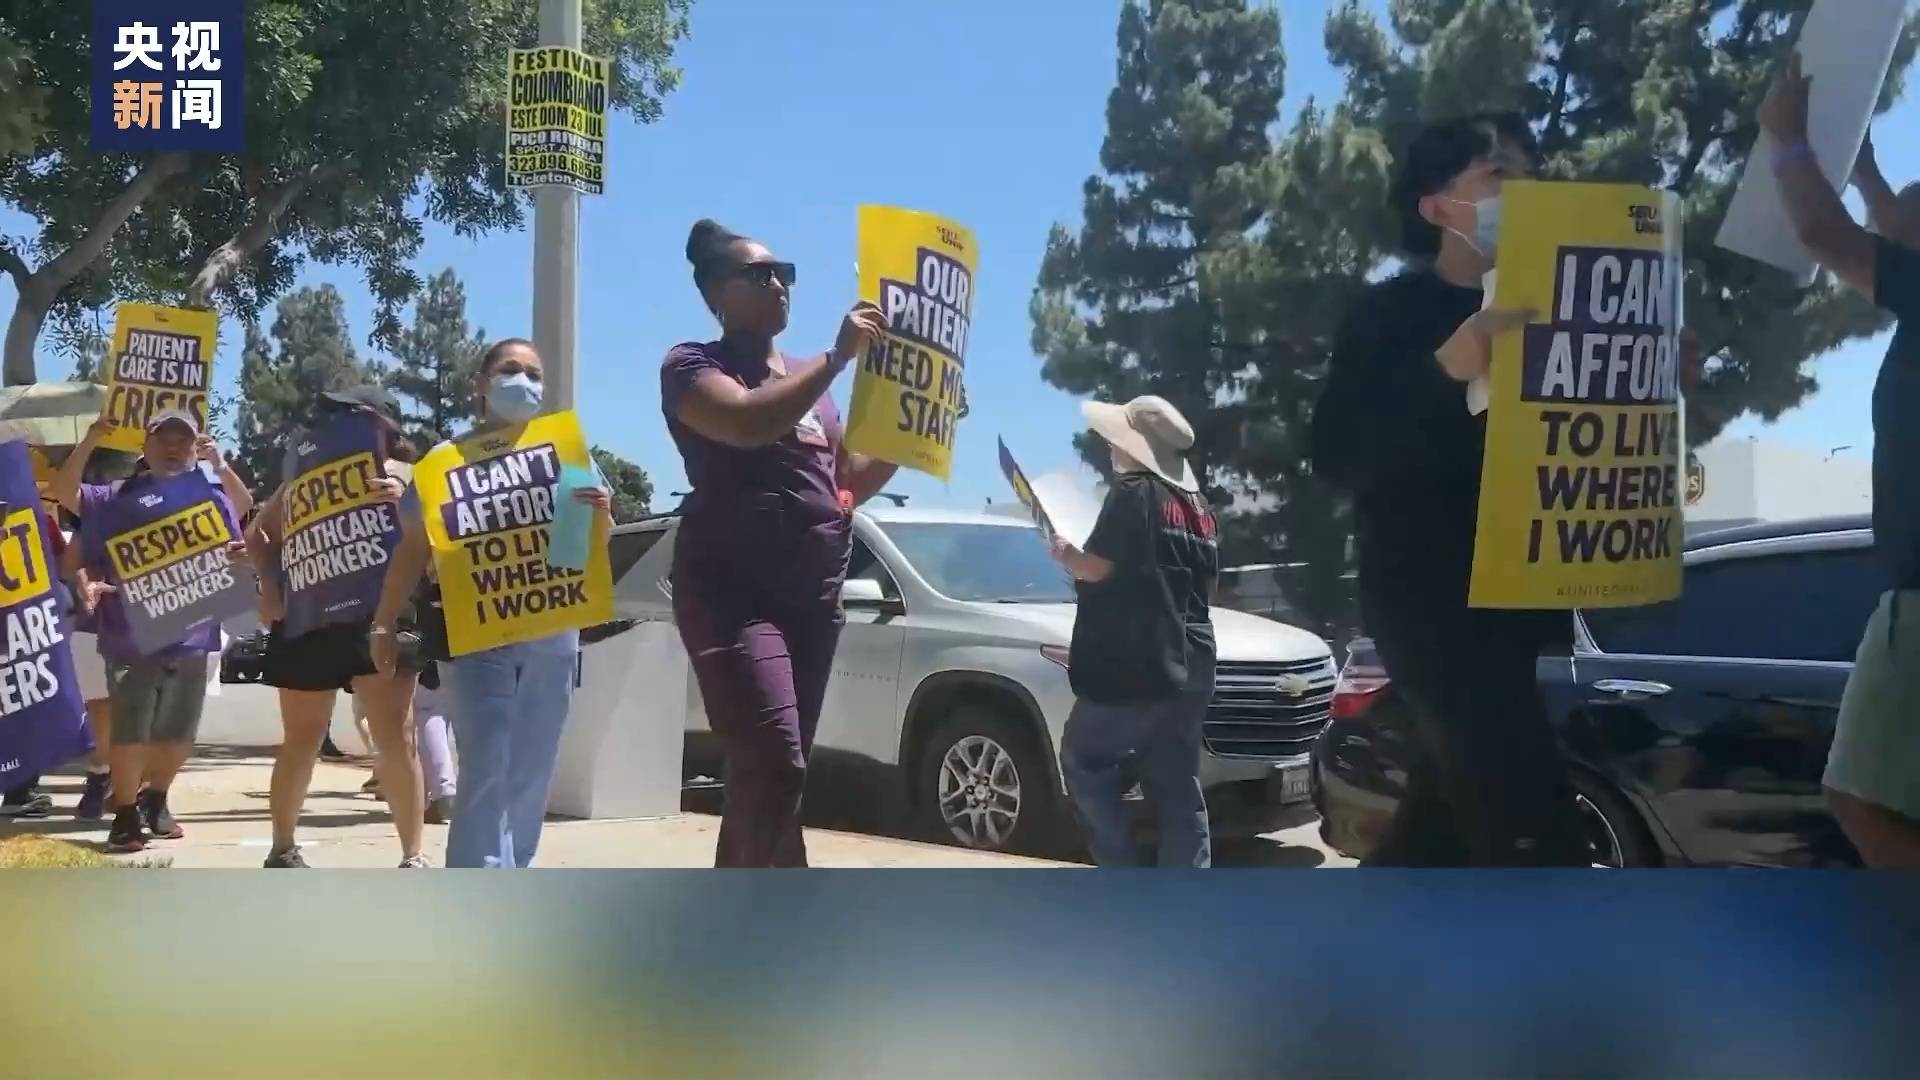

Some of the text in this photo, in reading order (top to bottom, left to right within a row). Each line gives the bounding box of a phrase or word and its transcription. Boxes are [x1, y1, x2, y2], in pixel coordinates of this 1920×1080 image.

[513, 49, 604, 80] FESTIVAL
[511, 71, 604, 115] COLOMBIANO
[511, 107, 537, 129] ESTE
[540, 105, 568, 127] DOM
[570, 110, 583, 132] 23
[510, 130, 601, 154] PICO RIVERA
[515, 143, 597, 163] SPORT ARENA
[511, 172, 600, 194] Ticketon.com
[921, 255, 969, 315] OUR
[1558, 255, 1673, 325] I CAN
[129, 332, 197, 361] PATIENT
[887, 284, 969, 358] PATIEN
[119, 355, 203, 387] CARE IS IN
[864, 338, 934, 391] NEED
[1540, 411, 1604, 458] TO
[284, 460, 373, 528] ESPECT
[450, 446, 556, 498] I CAN'T
[1537, 465, 1676, 511] WHERE
[456, 483, 559, 536] AFFOR
[114, 508, 221, 573] RESPECT
[281, 505, 394, 571] HEALTHCARE
[464, 536, 507, 565] TO
[1527, 517, 1671, 563] I WORK
[124, 548, 231, 603] HEALTHCAR
[288, 537, 388, 592] WORKERS
[143, 567, 234, 618] WORKERS
[476, 580, 589, 625] I WORK
[7, 597, 64, 662] ARE
[0, 653, 59, 715] ERS
